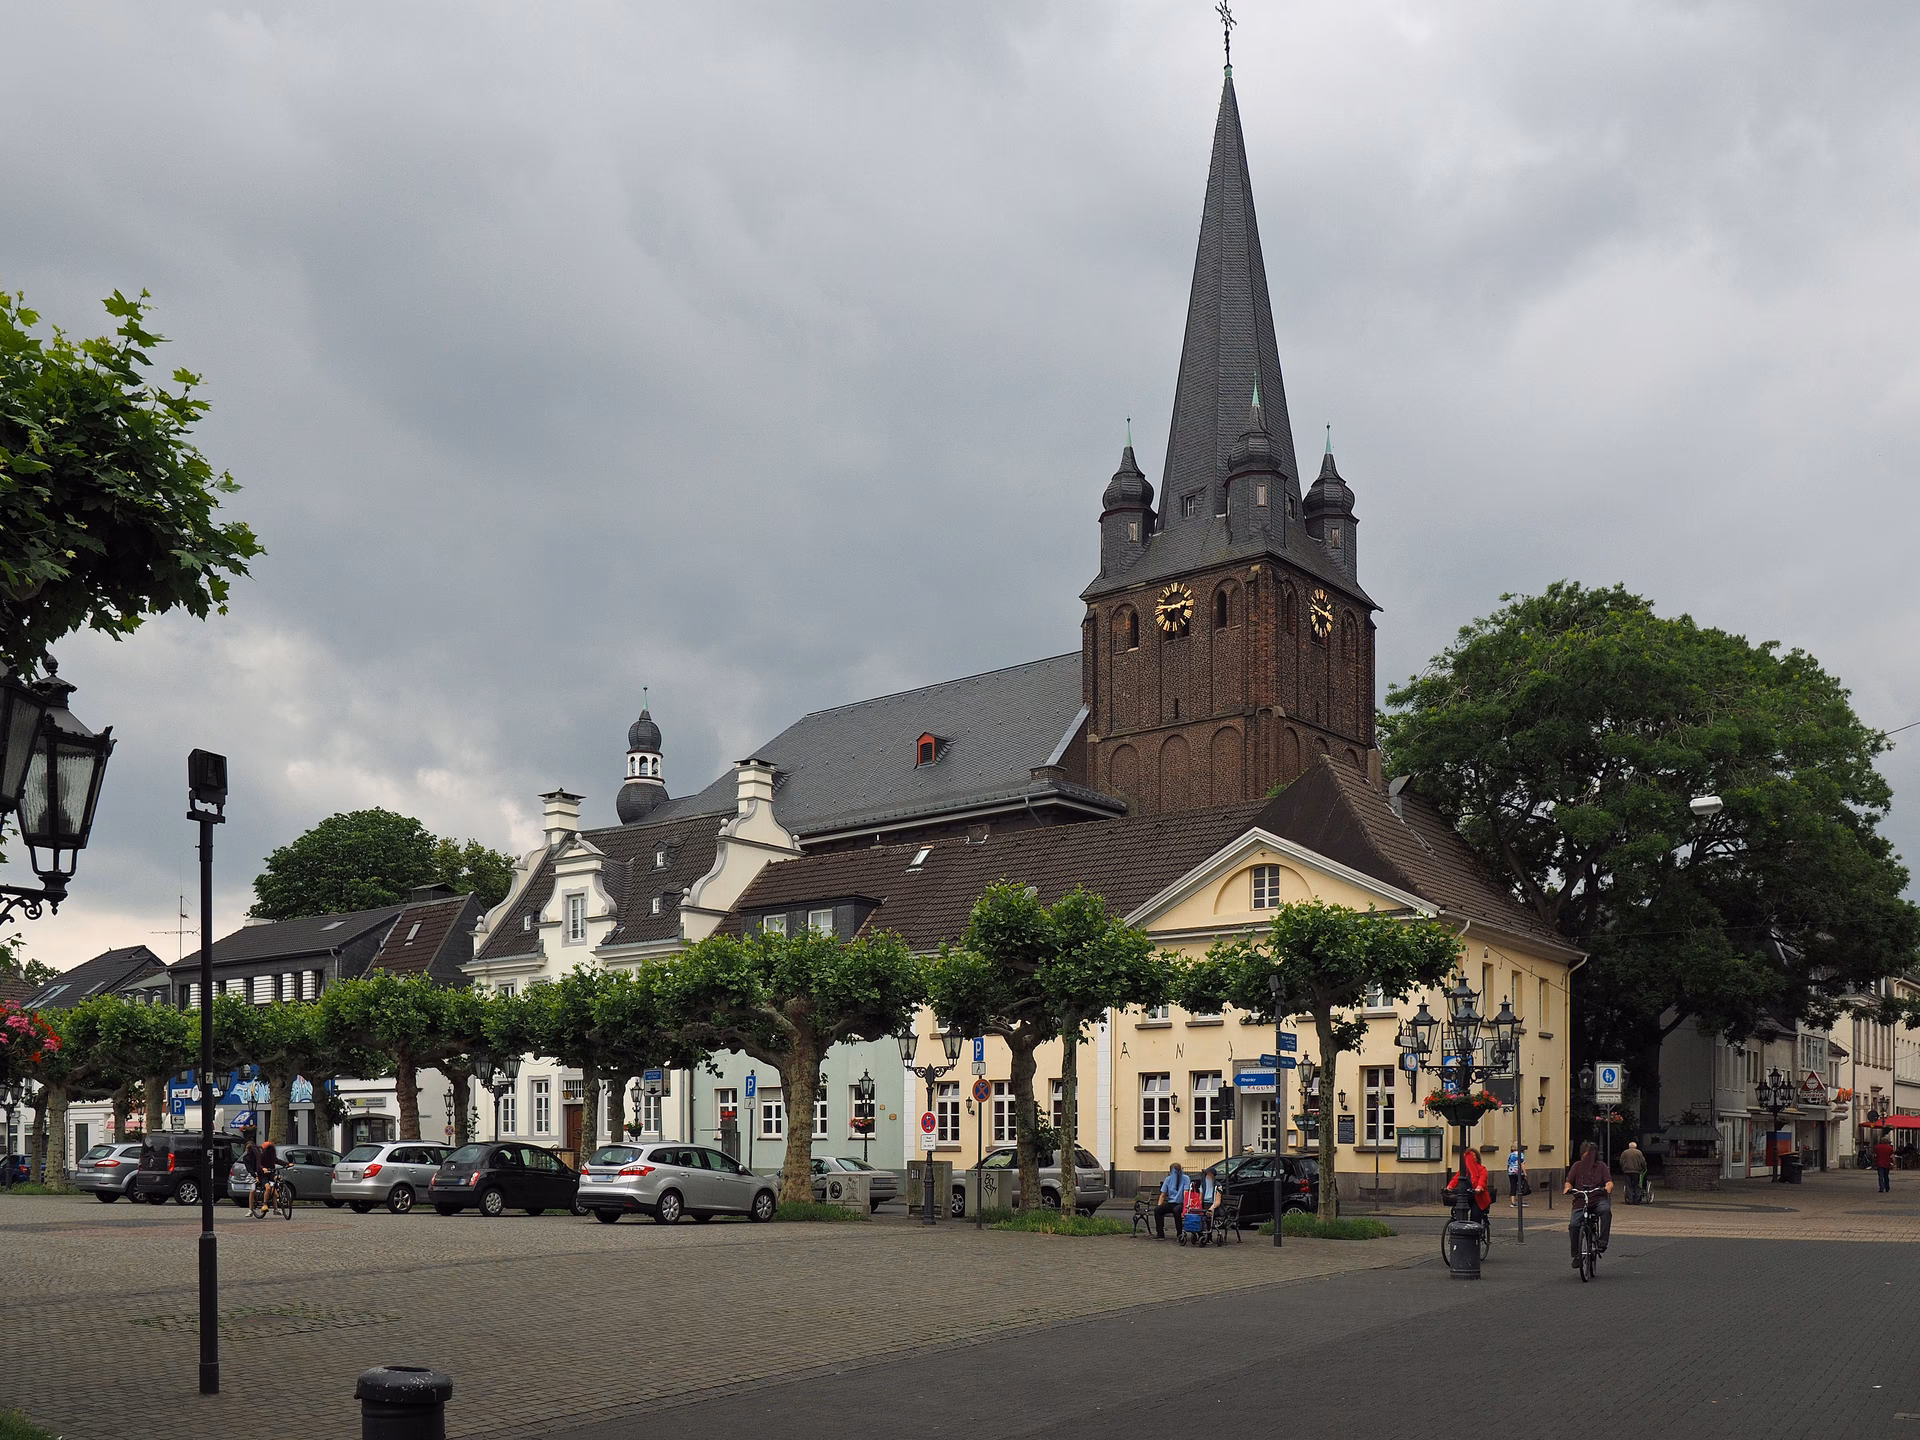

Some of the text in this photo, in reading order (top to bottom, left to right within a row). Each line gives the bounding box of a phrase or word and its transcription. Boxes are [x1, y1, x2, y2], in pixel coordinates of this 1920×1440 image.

[976, 1041, 982, 1059] P
[747, 1078, 754, 1095] P
[174, 1100, 182, 1113] P
